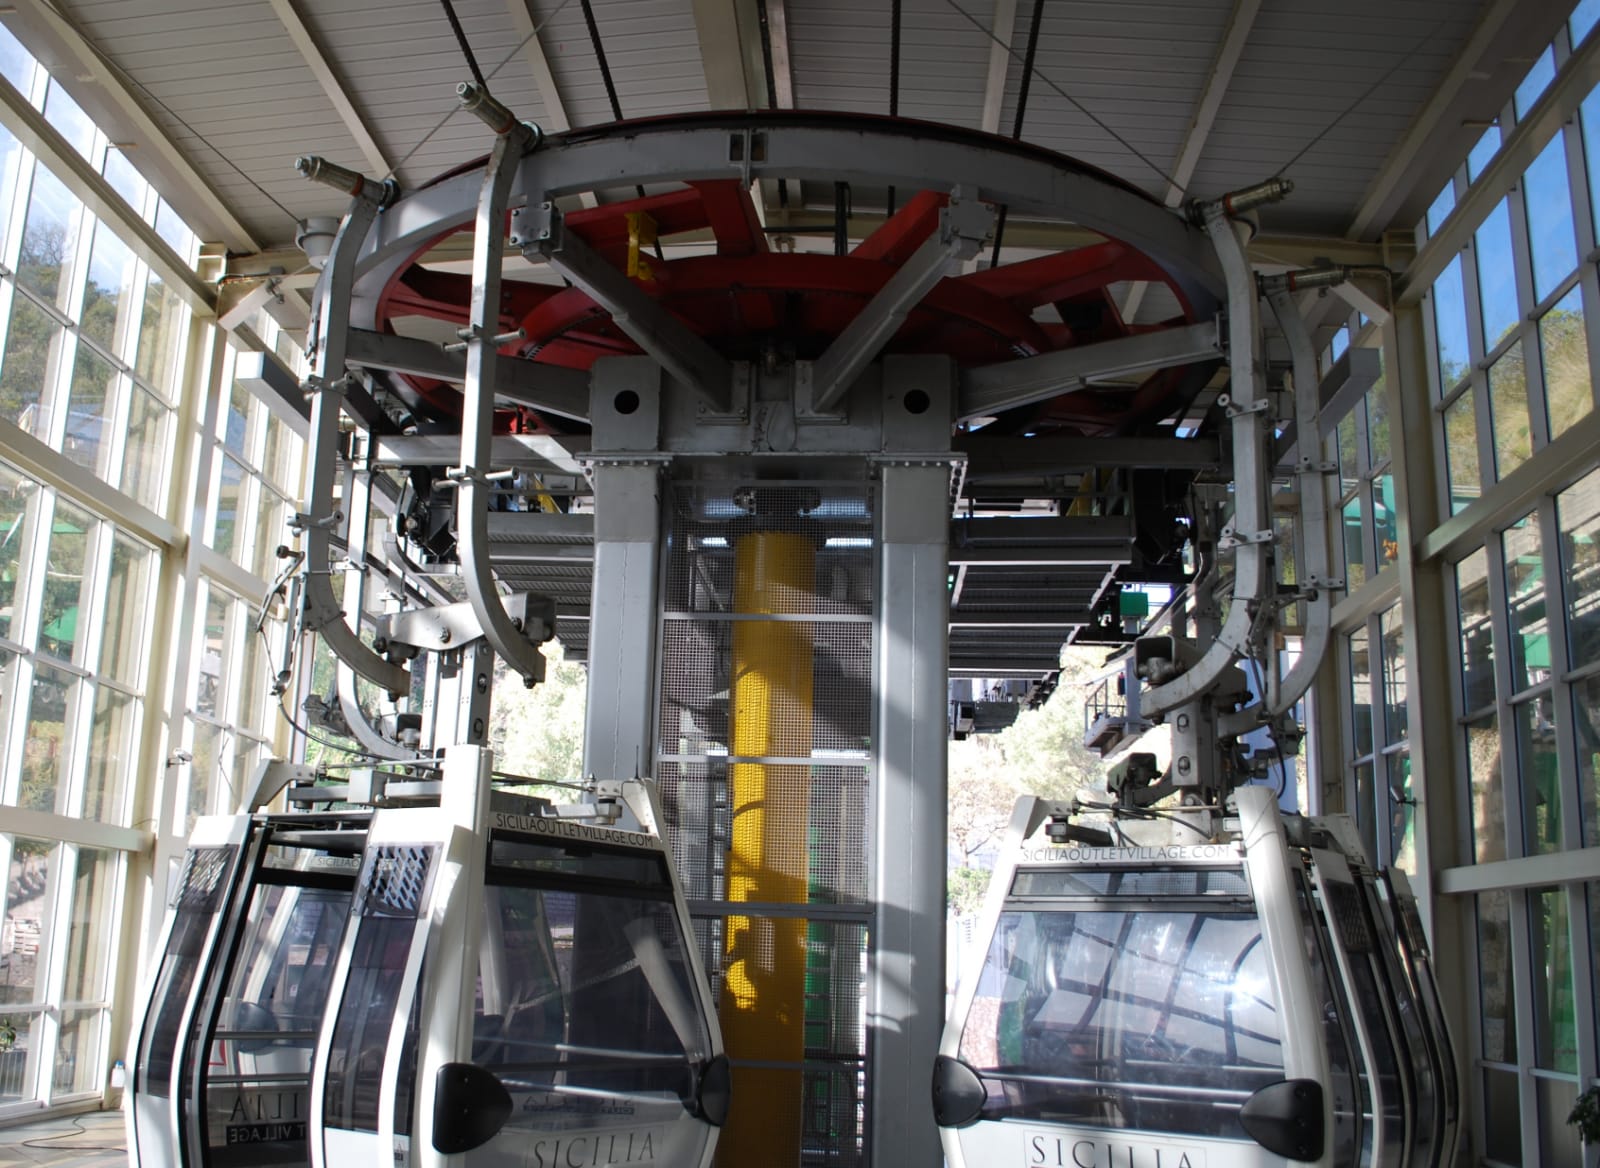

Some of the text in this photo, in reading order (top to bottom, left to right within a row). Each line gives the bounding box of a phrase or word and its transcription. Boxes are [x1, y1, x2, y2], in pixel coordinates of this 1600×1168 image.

[496, 813, 654, 848] SICILIAOUTLETVILLAGE.COM
[1023, 845, 1229, 862] SICILIAOUTLETVILLAGE.COM
[534, 1131, 654, 1168] SICILIA
